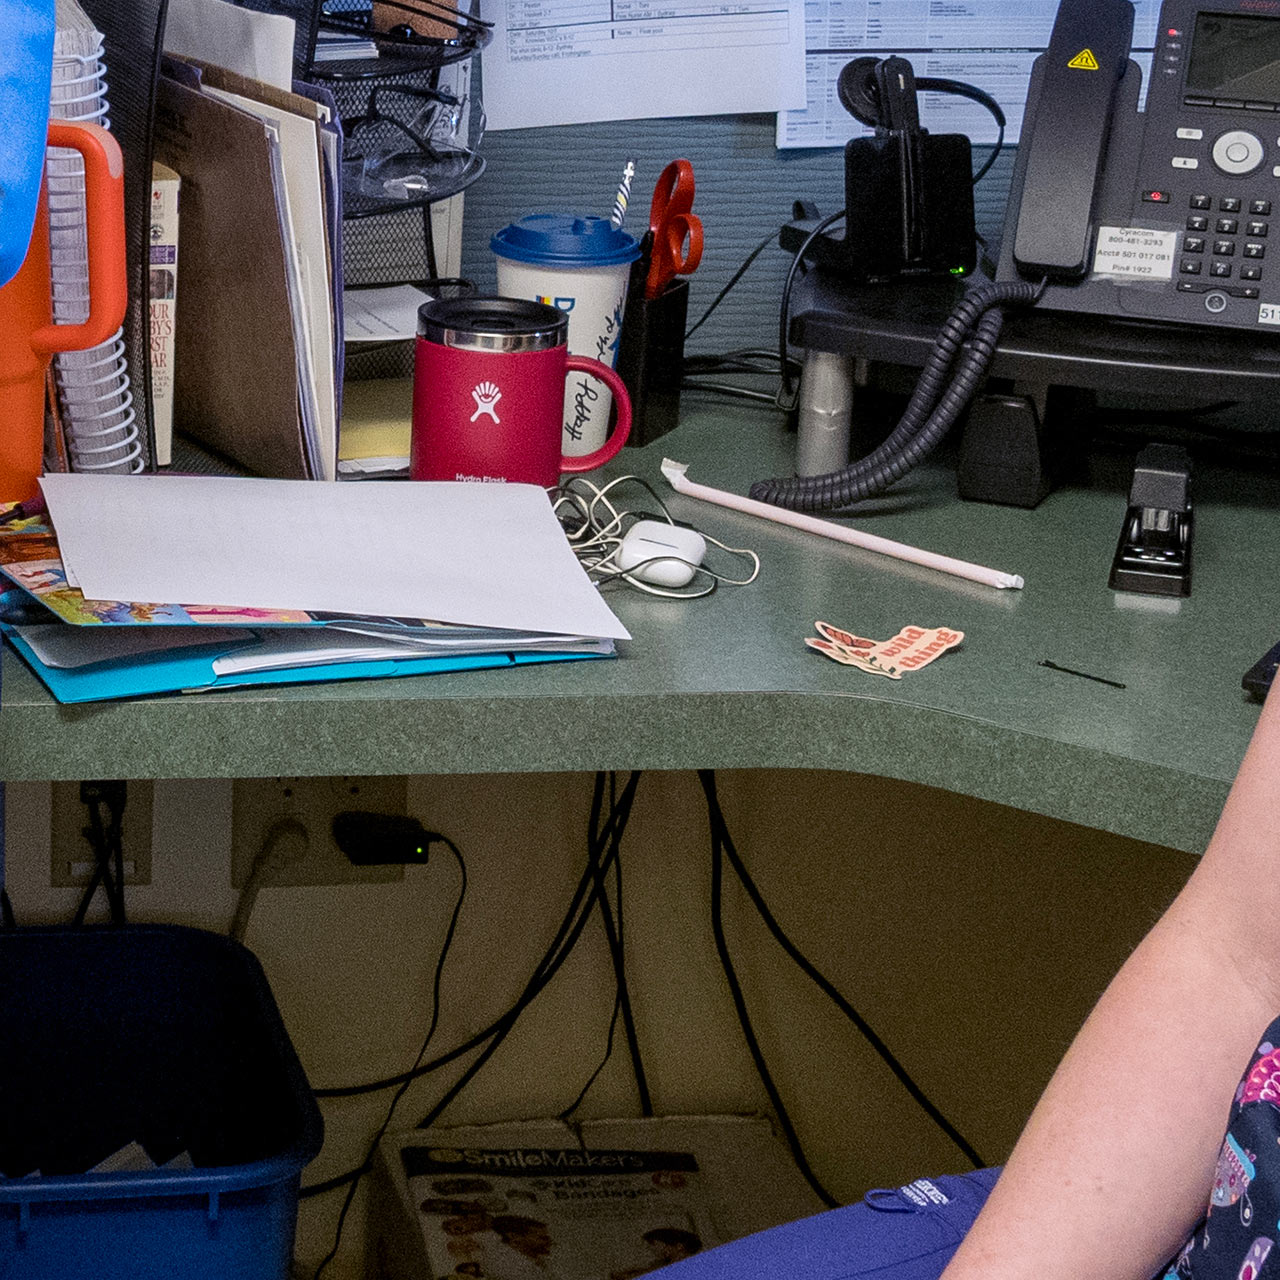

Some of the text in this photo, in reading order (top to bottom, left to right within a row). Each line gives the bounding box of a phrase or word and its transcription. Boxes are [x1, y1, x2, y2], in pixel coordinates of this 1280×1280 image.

[149, 303, 170, 319] OUR
[150, 319, 172, 336] BY'S
[152, 352, 167, 368] AR
[564, 378, 599, 442] Happy
[455, 473, 507, 484] Hydro Flask
[879, 627, 926, 658] wild
[899, 629, 959, 668] thing
[463, 1150, 645, 1169] SmileMakers
